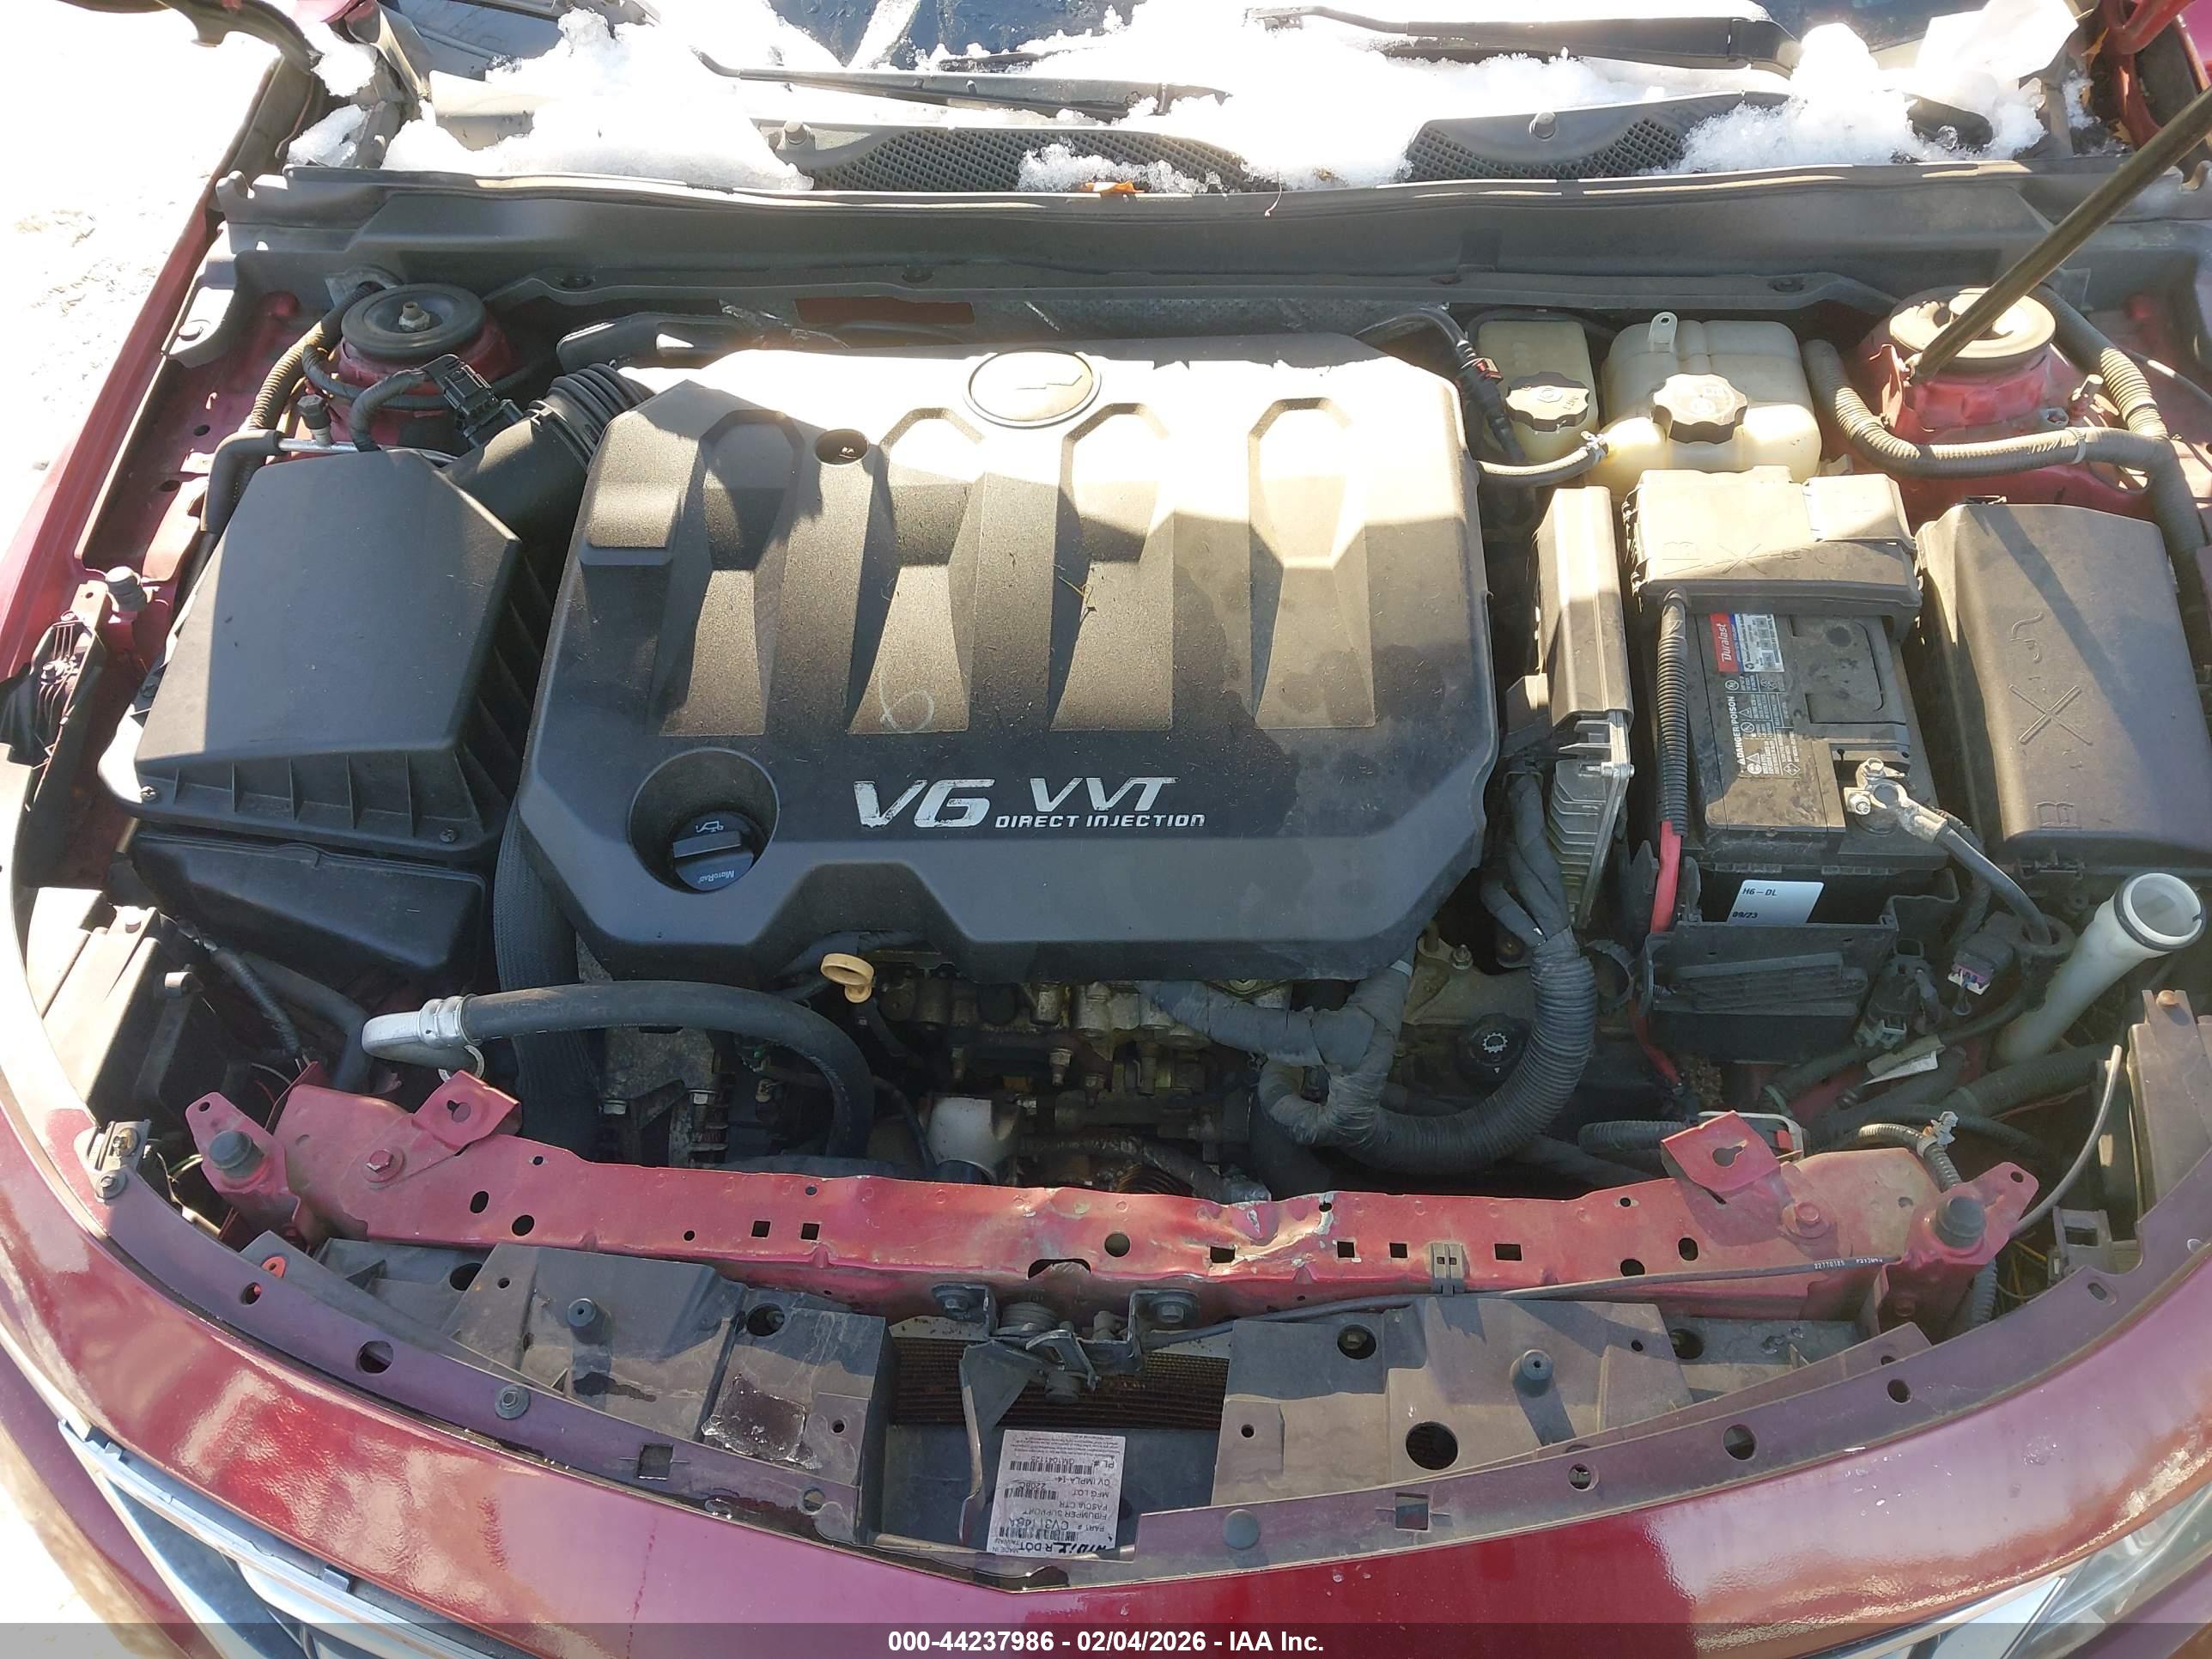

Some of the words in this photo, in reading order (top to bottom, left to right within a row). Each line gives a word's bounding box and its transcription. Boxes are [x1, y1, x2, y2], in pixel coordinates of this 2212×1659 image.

[1717, 623, 1732, 662] Duralast
[1726, 696, 1744, 758] DANGER/POISON
[854, 778, 995, 830] V6
[1029, 776, 1181, 812] VVT
[994, 814, 1079, 829] DIRECT
[1085, 814, 1206, 828] INJECTION
[1030, 1455, 1075, 1465] GM1041125
[1078, 1502, 1108, 1510] FASCIA
